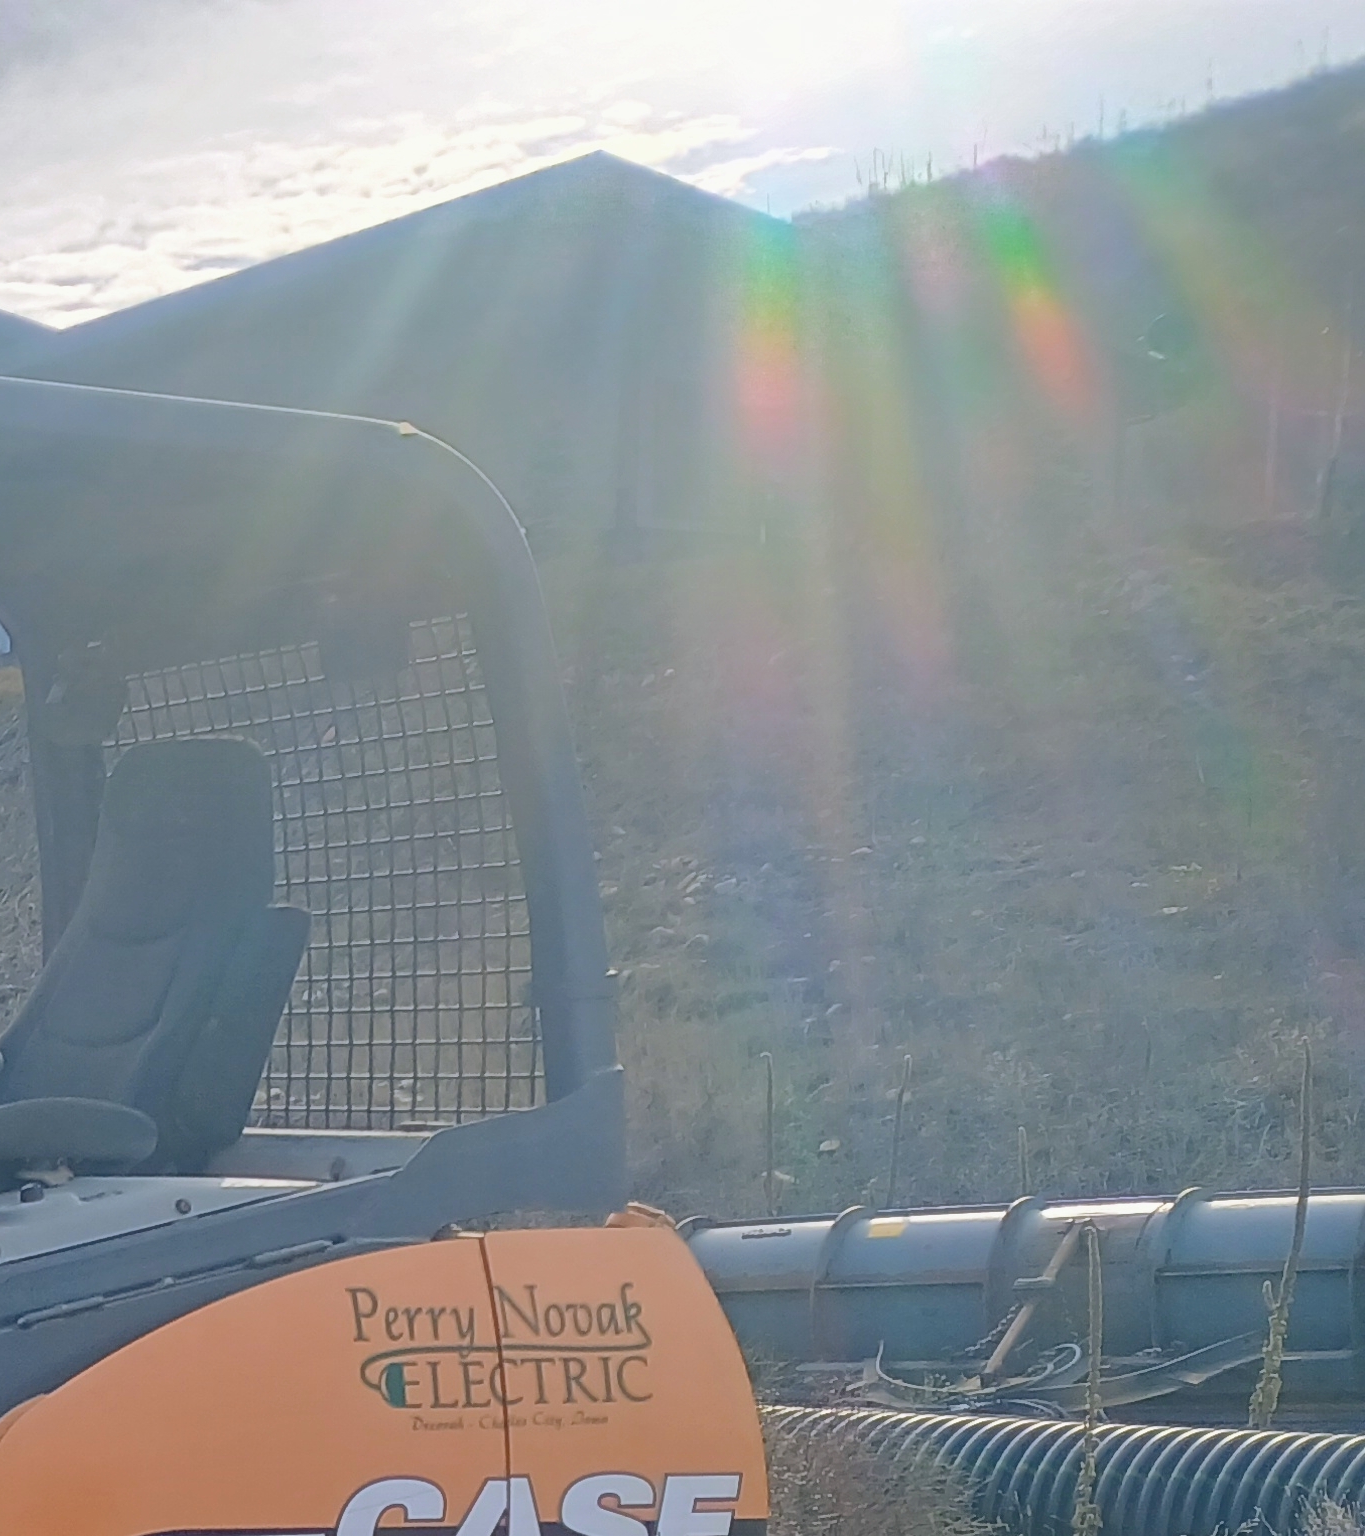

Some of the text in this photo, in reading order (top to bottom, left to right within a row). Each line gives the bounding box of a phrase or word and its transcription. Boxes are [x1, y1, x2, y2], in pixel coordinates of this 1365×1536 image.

[345, 1282, 652, 1358] Perry Novak
[379, 1355, 654, 1409] ELECTRIC
